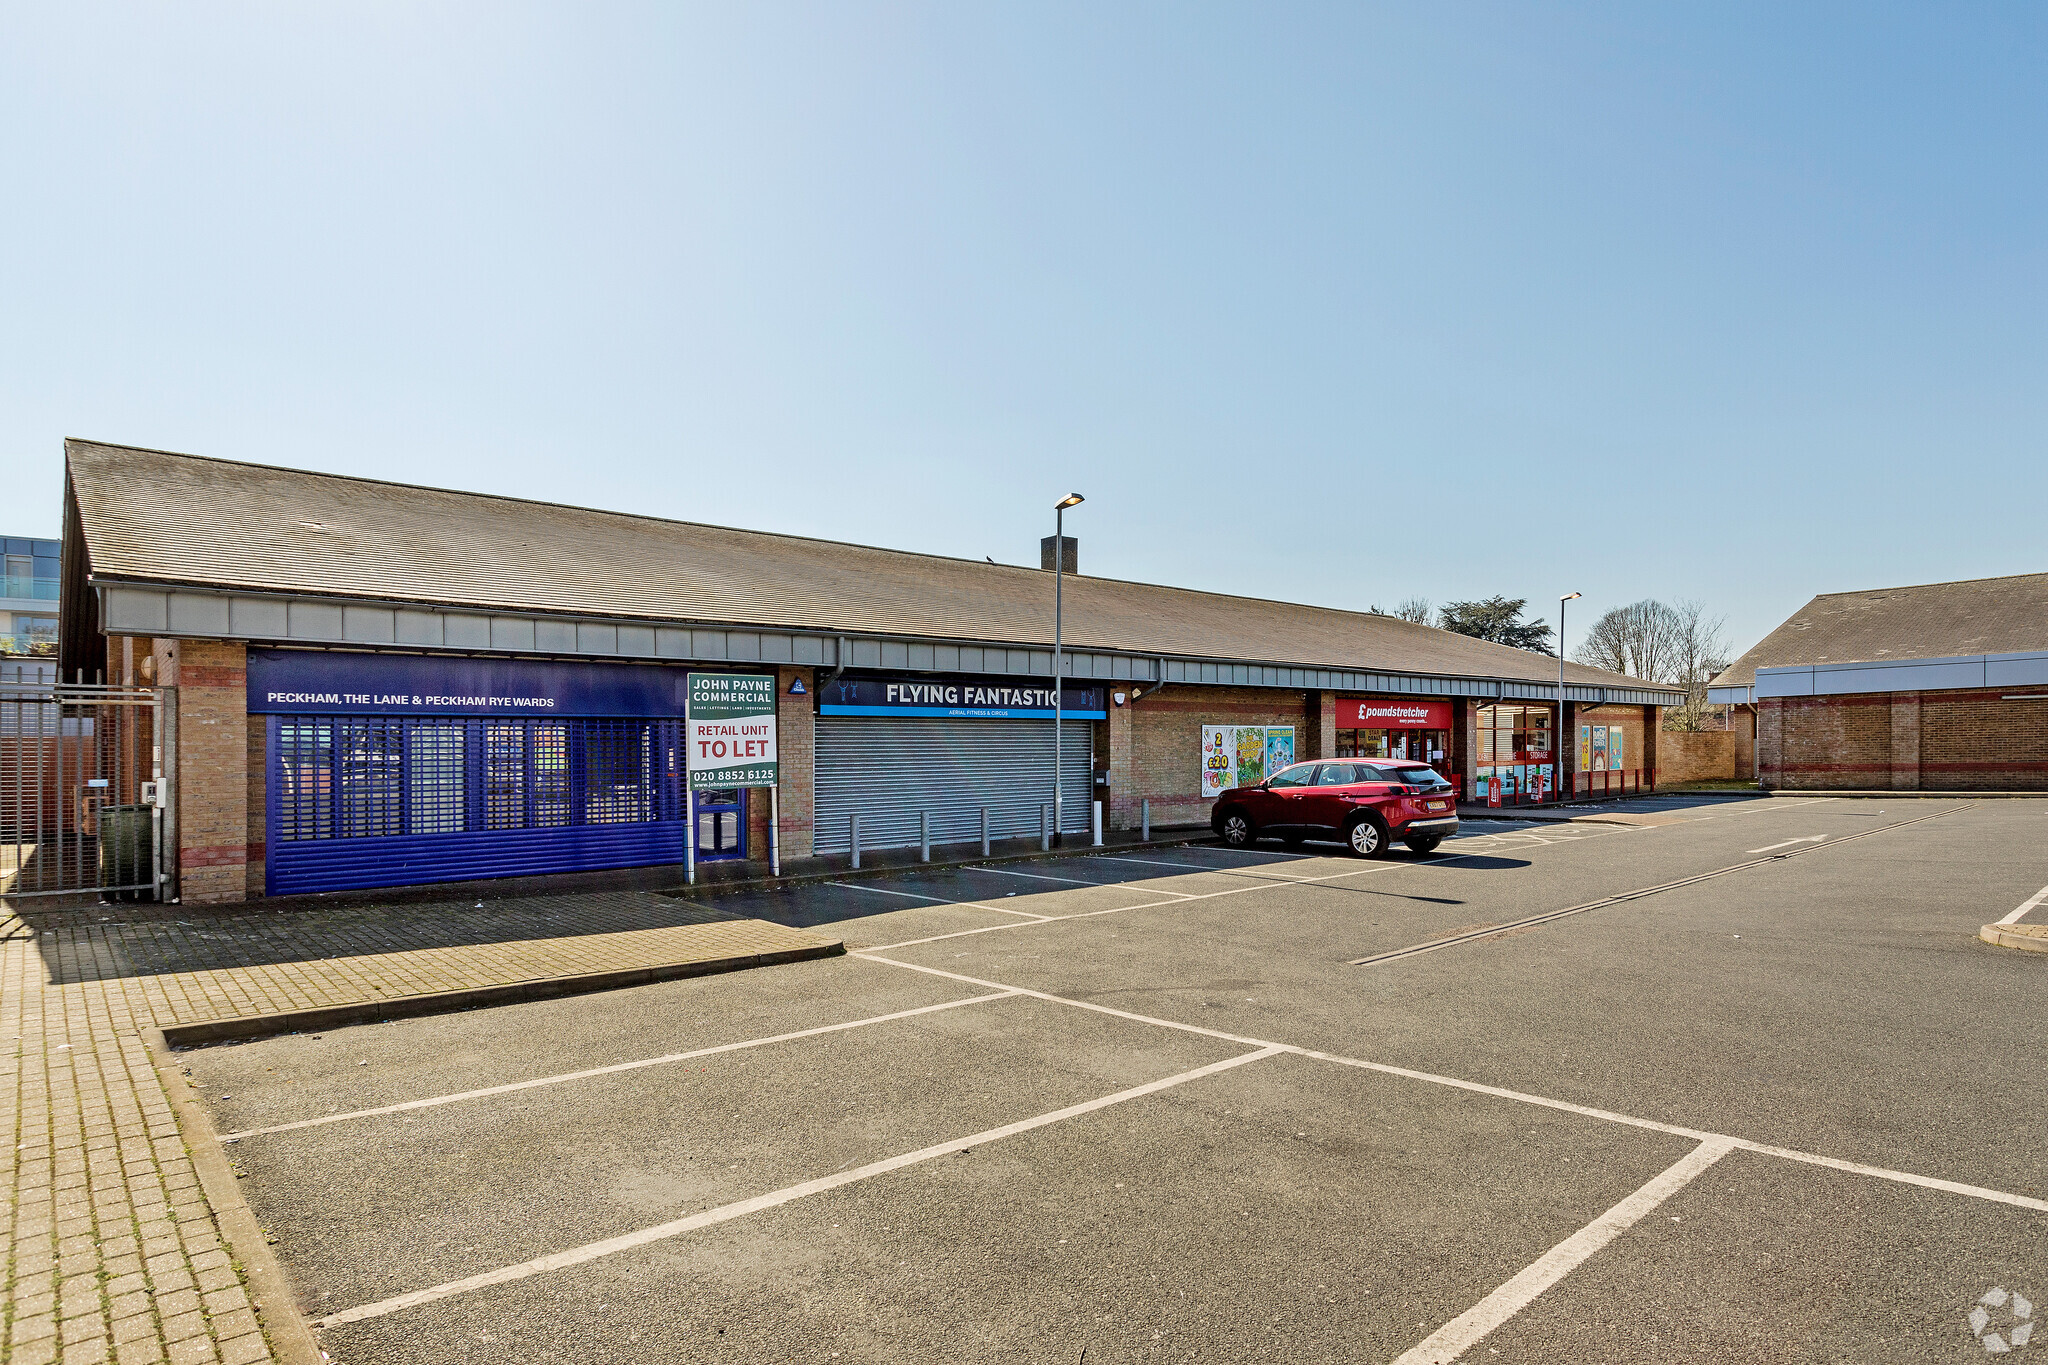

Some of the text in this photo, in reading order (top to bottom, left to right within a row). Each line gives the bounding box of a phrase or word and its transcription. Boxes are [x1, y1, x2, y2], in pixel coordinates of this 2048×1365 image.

[693, 680, 771, 691] JOHN PAYNE
[267, 692, 554, 707] PECKHAM, THE LANE & PECKHAM RYE WARDS
[693, 692, 771, 702] COMMERCIAL
[886, 684, 958, 704] FLYING
[698, 725, 768, 736] RETAIL UNIT
[1215, 733, 1222, 747] 2
[698, 740, 768, 758] TO LET
[1237, 741, 1263, 751] GARDEN
[1242, 750, 1258, 759] SHOP
[1530, 751, 1548, 759] STORAGE
[1208, 755, 1228, 770] £20
[693, 770, 774, 781] 020 8852 6125
[1204, 771, 1233, 788] TOYS
[694, 780, 774, 788] www.johnpaynecommercial.com
